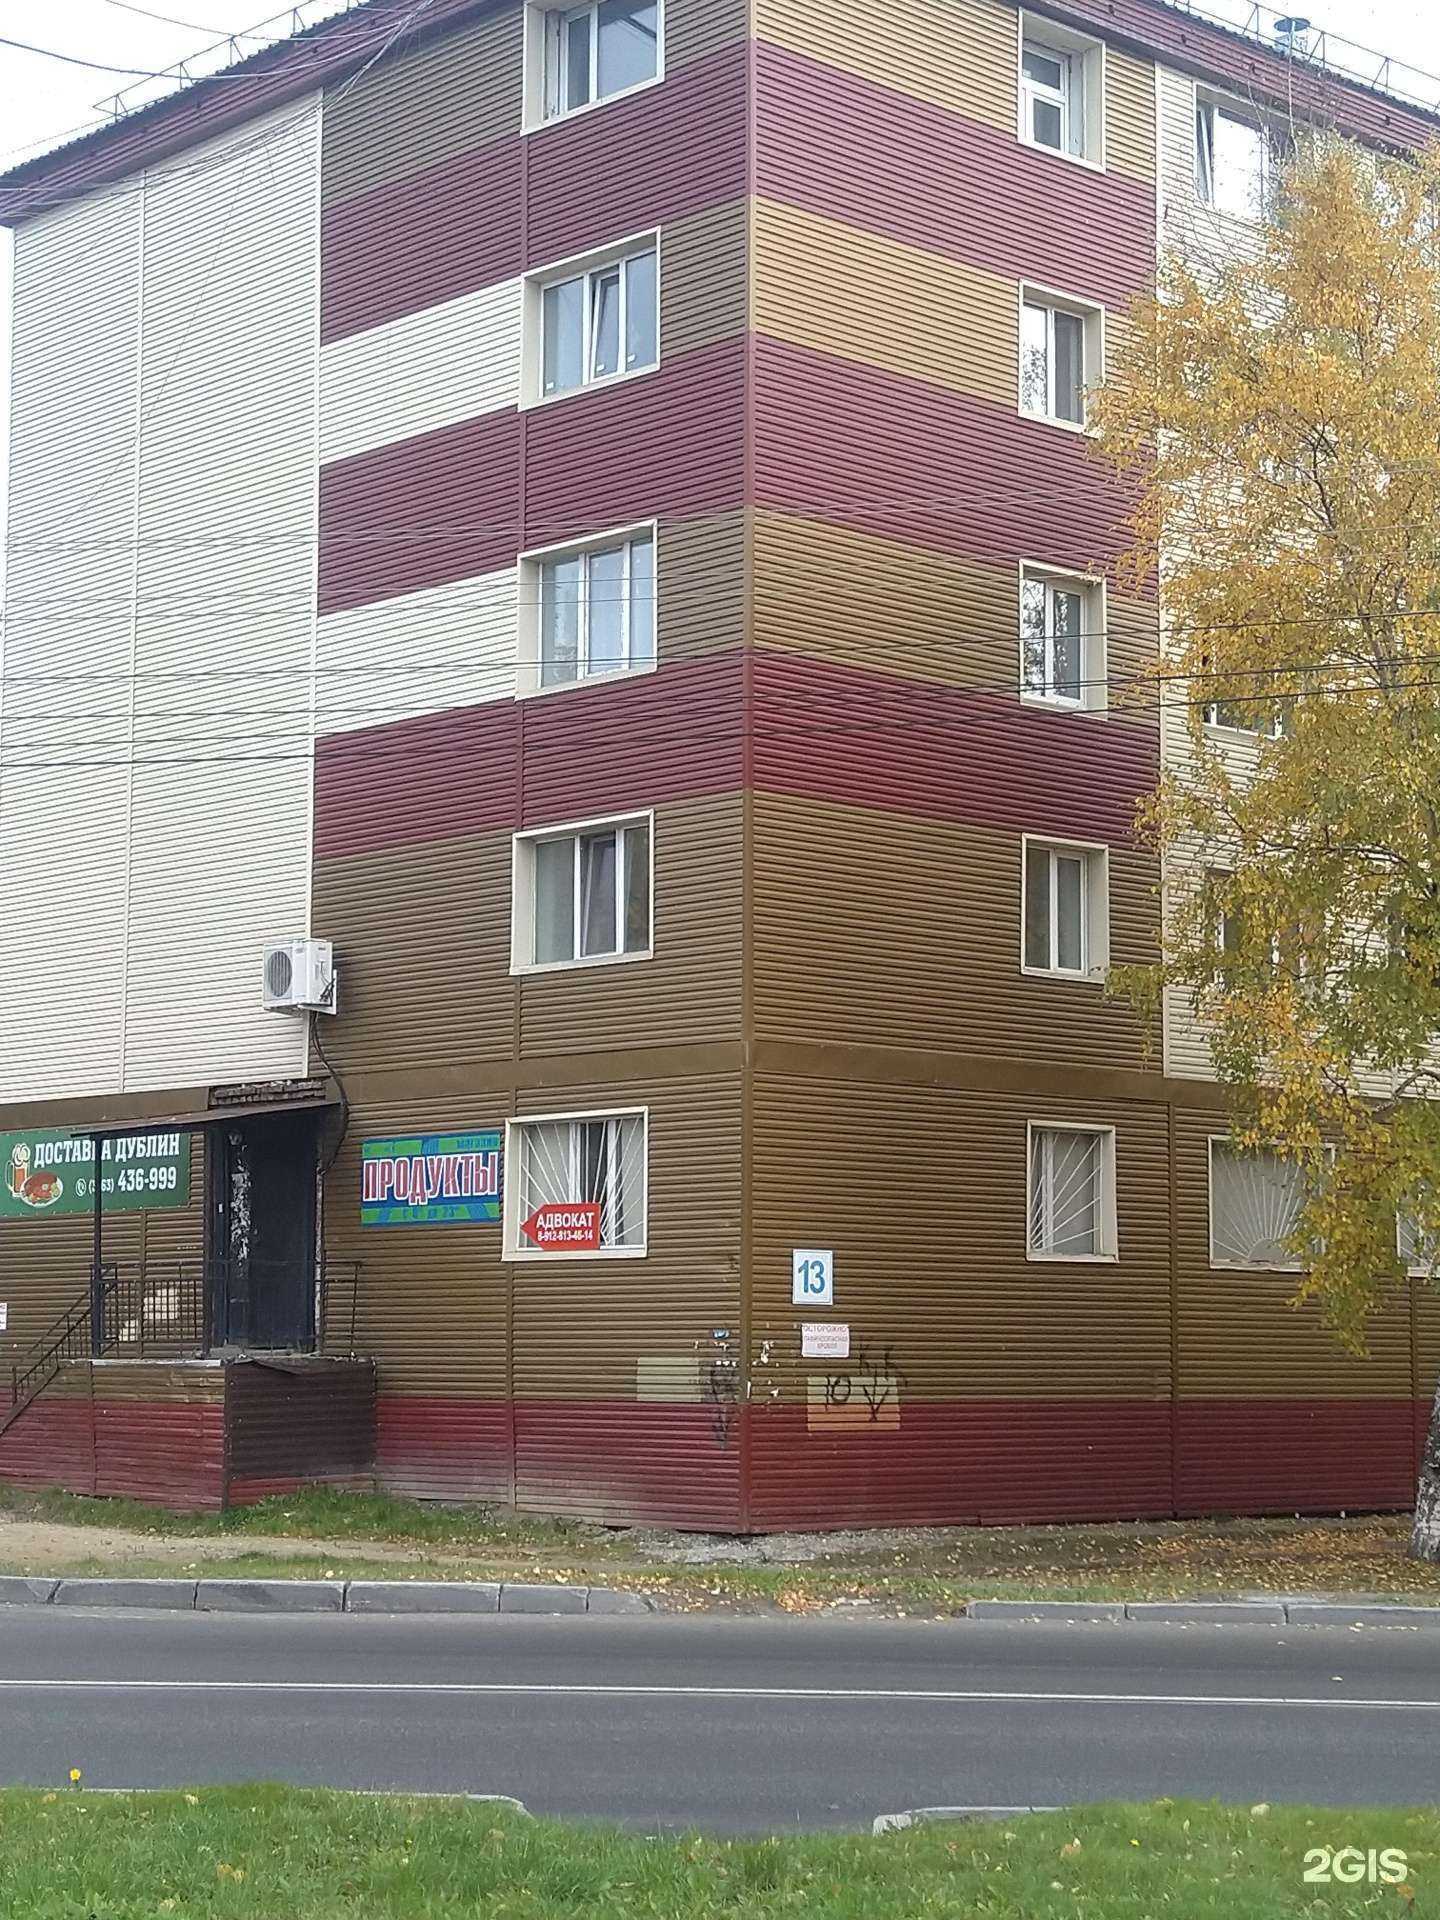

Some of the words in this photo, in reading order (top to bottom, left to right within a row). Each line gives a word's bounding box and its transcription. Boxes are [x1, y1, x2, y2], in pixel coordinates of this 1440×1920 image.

[34, 1138, 112, 1168] ДОСТАВА
[115, 1134, 181, 1162] ДУБЛИН
[117, 1166, 177, 1192] 436-999
[363, 1152, 498, 1205] ПРОДУКТЫ
[536, 1212, 595, 1231] АДВОКАТ
[798, 1260, 826, 1294] 13
